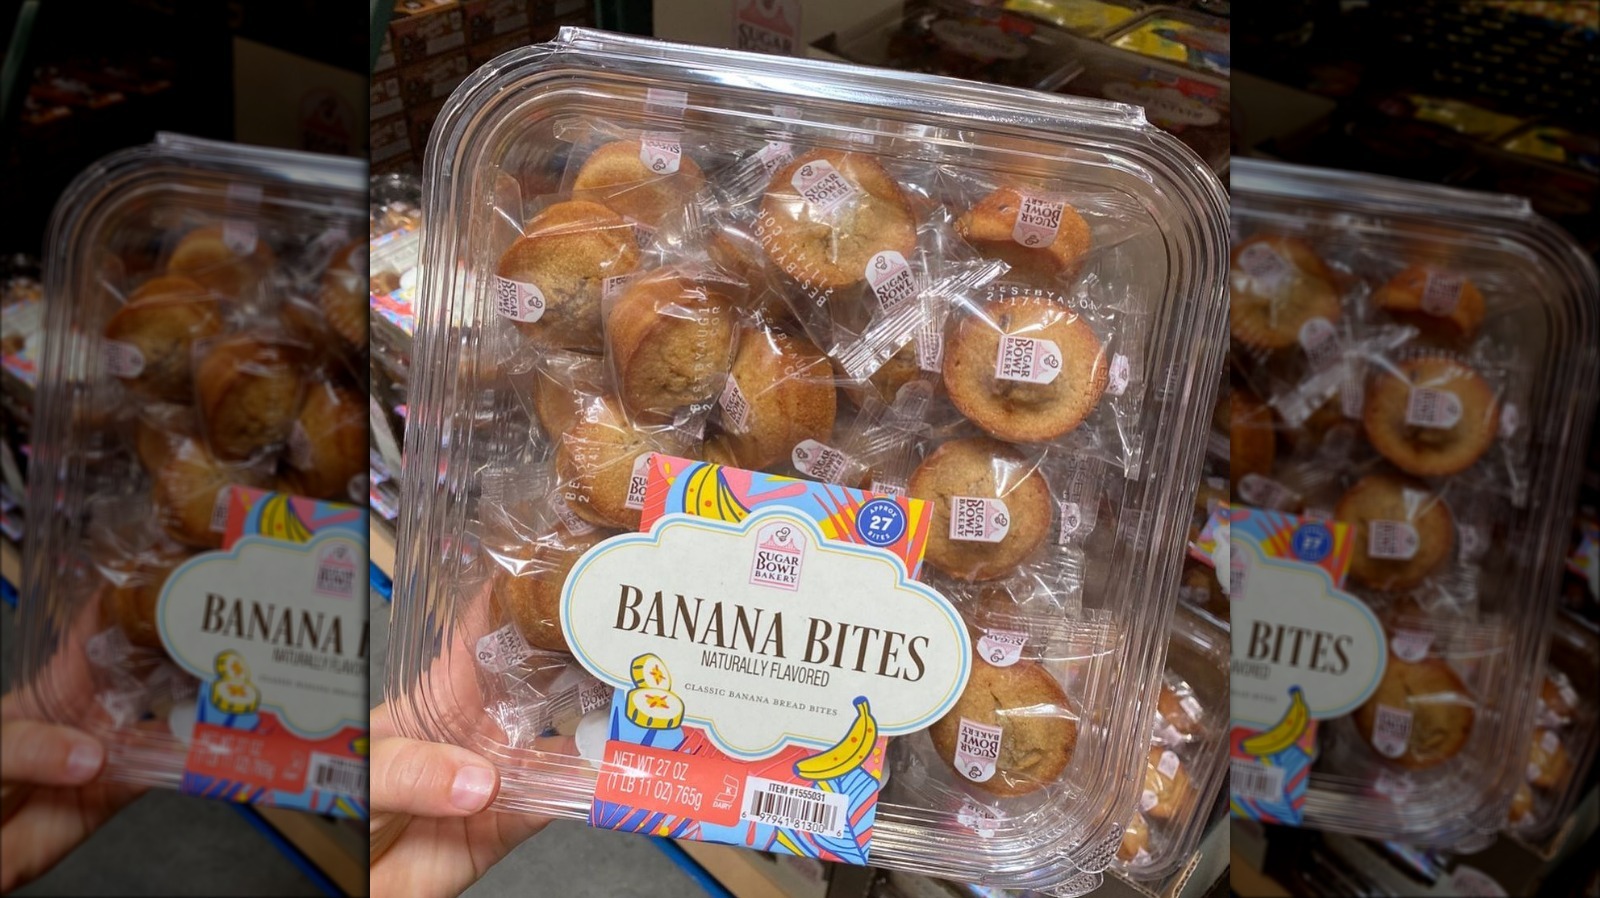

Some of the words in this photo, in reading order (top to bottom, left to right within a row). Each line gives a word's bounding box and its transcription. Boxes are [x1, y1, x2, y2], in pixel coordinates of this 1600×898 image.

[805, 173, 839, 198] SUGAR
[808, 180, 845, 204] BOWL
[1021, 212, 1058, 229] SUGAR
[1024, 203, 1062, 222] BOWL
[876, 270, 909, 295] SUGAR
[879, 278, 913, 304] BOWL
[501, 280, 511, 315] BOWL
[509, 282, 518, 317] SUGAR
[883, 285, 914, 310] BAKERY
[986, 292, 1053, 306] 211741
[1003, 337, 1015, 376] BAKERY
[1010, 338, 1027, 377] BOWL
[1021, 340, 1034, 378] SUGAR
[726, 386, 739, 412] SUGAR
[811, 449, 832, 476] SUGAR
[630, 483, 647, 496] BO
[869, 515, 894, 531] 27
[870, 504, 897, 518] APPROX
[957, 498, 966, 537] BAKERY
[965, 499, 977, 537] BOWL
[974, 499, 985, 537] SUGAR
[867, 530, 890, 541] BITES
[756, 558, 798, 576] BOWL
[758, 550, 799, 566] SUGAR
[755, 570, 797, 583] BAKERY
[200, 592, 344, 656] BANANA
[613, 583, 787, 659] BANANA
[801, 617, 929, 682] BITES
[1247, 620, 1353, 676] BITES
[701, 650, 769, 677] NATURALLY
[770, 662, 830, 688] FLAVORED
[685, 682, 726, 697] CLASSIC
[729, 690, 770, 705] BANANA
[773, 698, 806, 711] BREAD
[809, 703, 838, 717] BITES
[961, 732, 998, 752] BOWL
[962, 726, 1000, 741] BAKERY
[960, 741, 997, 758] SUGAR
[613, 750, 635, 768] NET
[637, 754, 655, 774] WT
[655, 758, 671, 777] 27
[672, 761, 689, 781] OZ
[606, 772, 620, 793] (1
[620, 773, 636, 793] LB
[638, 777, 652, 797] 11
[654, 780, 673, 805] OZ)
[675, 784, 703, 811] 765g
[769, 783, 788, 795] ITEM
[789, 788, 826, 802] #1555031
[712, 800, 733, 810] DAIRY
[741, 810, 747, 818] 6
[759, 812, 789, 827] 97941
[794, 819, 825, 834] 81300
[836, 829, 842, 837] 6
